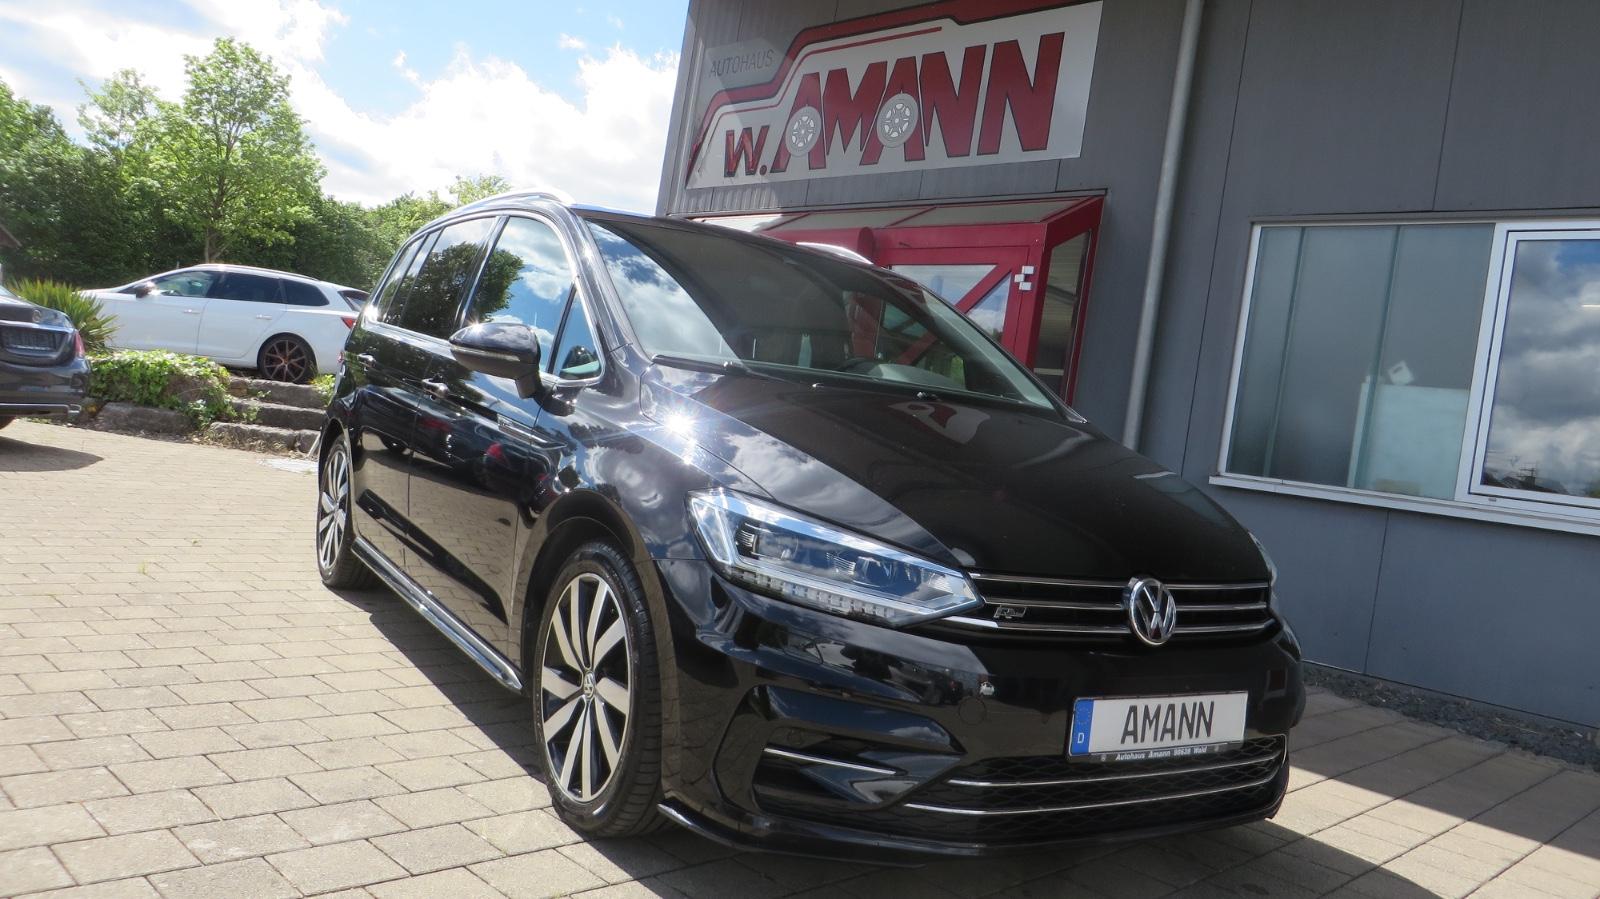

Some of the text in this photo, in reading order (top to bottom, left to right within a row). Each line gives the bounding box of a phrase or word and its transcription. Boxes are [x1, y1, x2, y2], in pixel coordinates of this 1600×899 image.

[709, 48, 775, 77] AUTOHAUS
[1077, 700, 1215, 744] D AMANN
[1115, 752, 1145, 761] Autohaus
[1148, 749, 1171, 758] Amann
